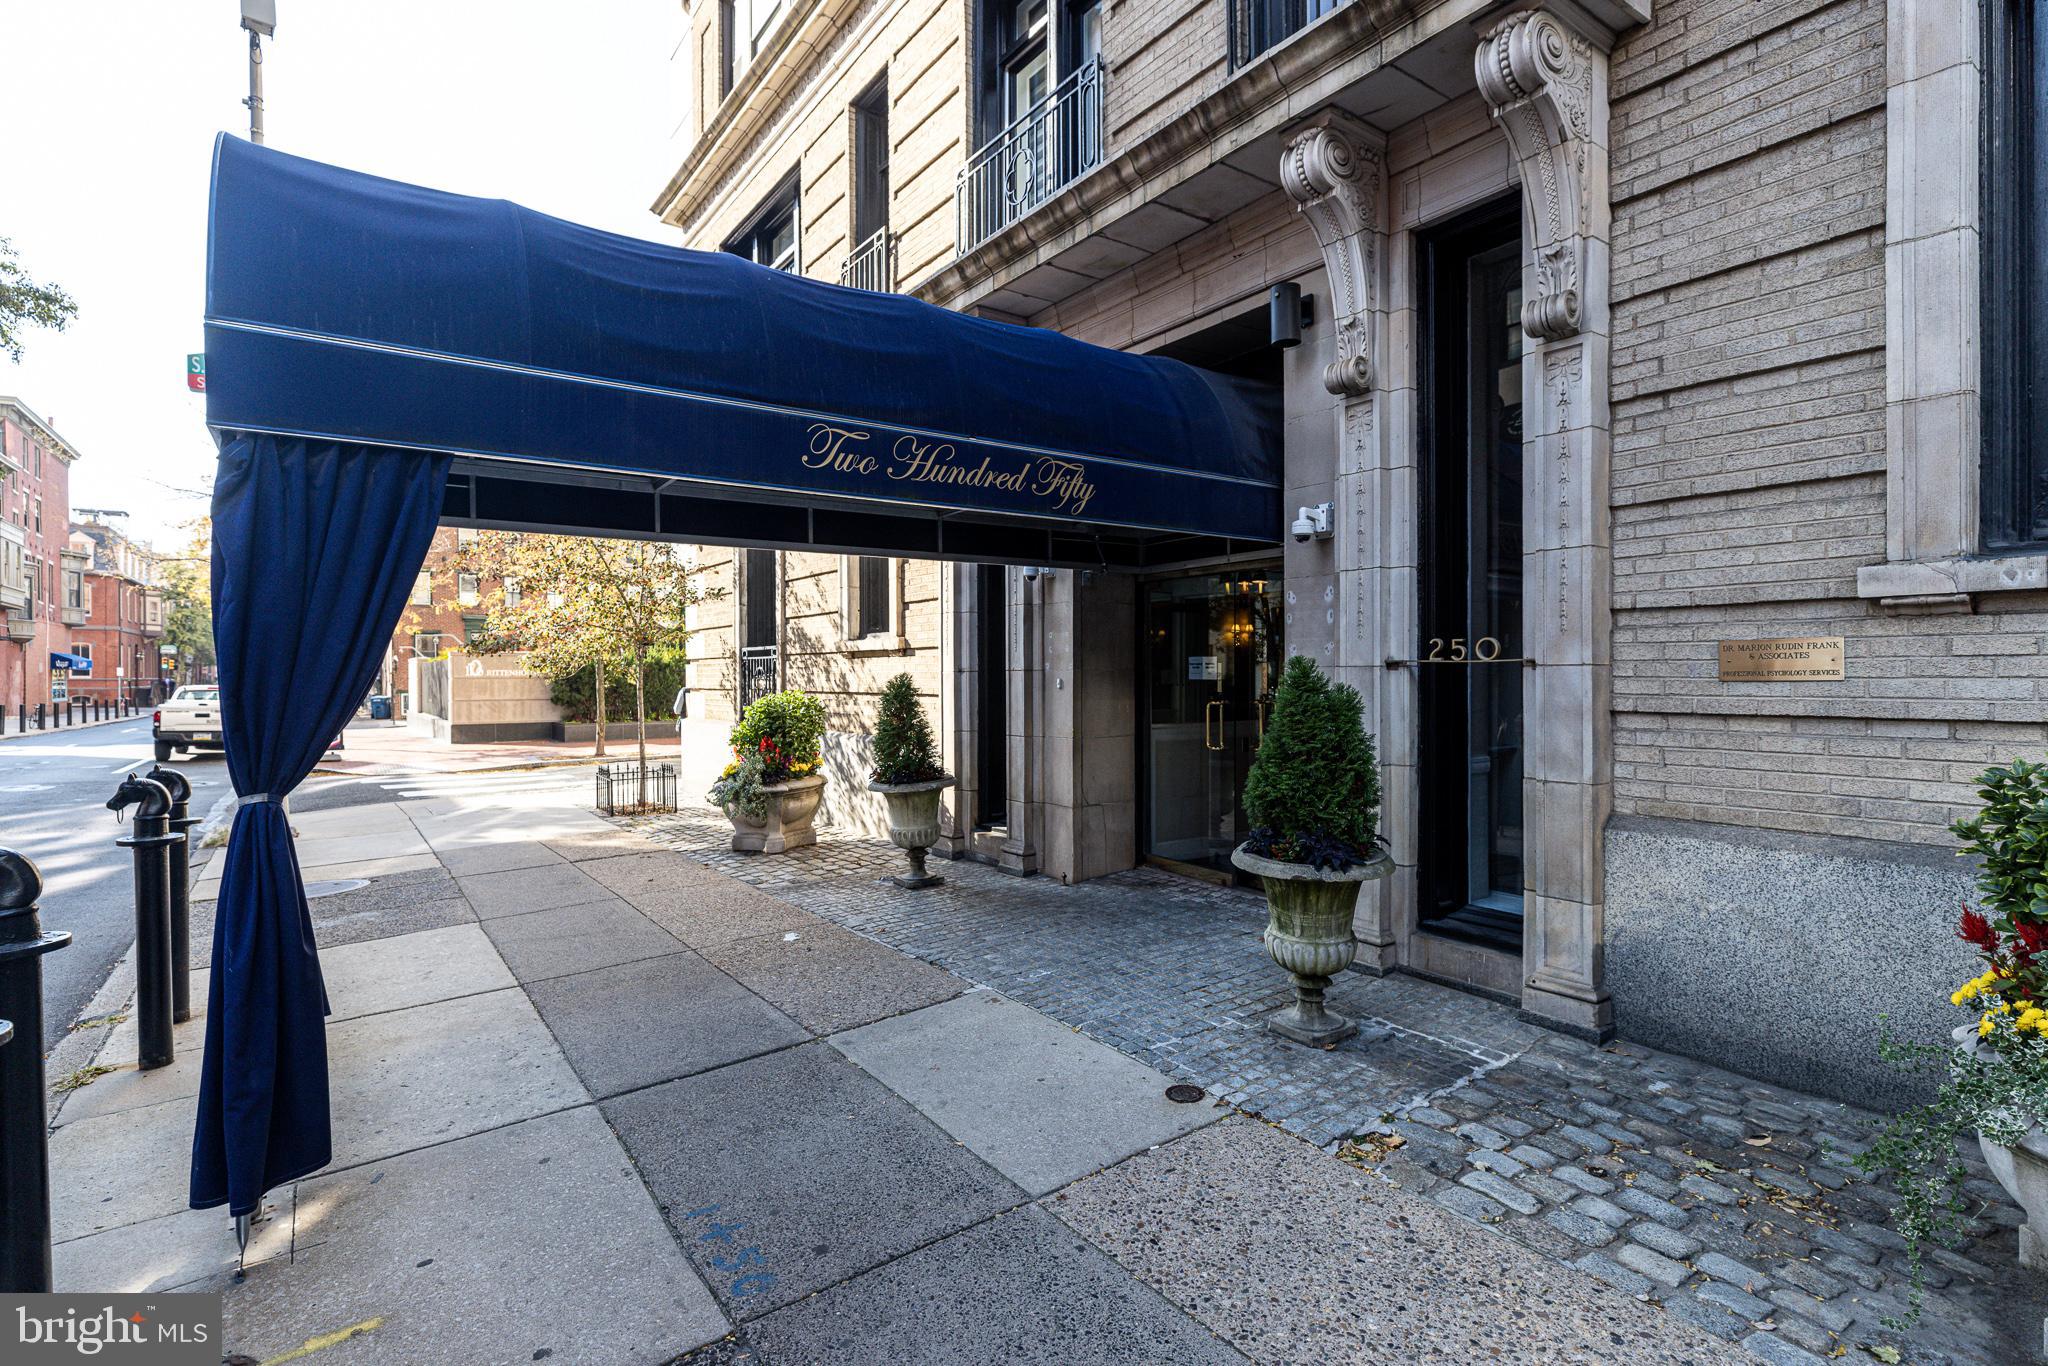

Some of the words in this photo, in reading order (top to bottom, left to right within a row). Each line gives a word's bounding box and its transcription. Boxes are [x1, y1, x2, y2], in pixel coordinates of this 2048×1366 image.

[802, 423, 879, 475] Two
[887, 435, 1030, 492] Hundred
[1031, 456, 1096, 515] Fifty
[1429, 637, 1501, 662] 250
[1737, 643, 1773, 652] MARION
[1775, 642, 1804, 651] RUDIN
[1807, 641, 1840, 650] FRANK
[1758, 652, 1810, 660] ASSOCIATES
